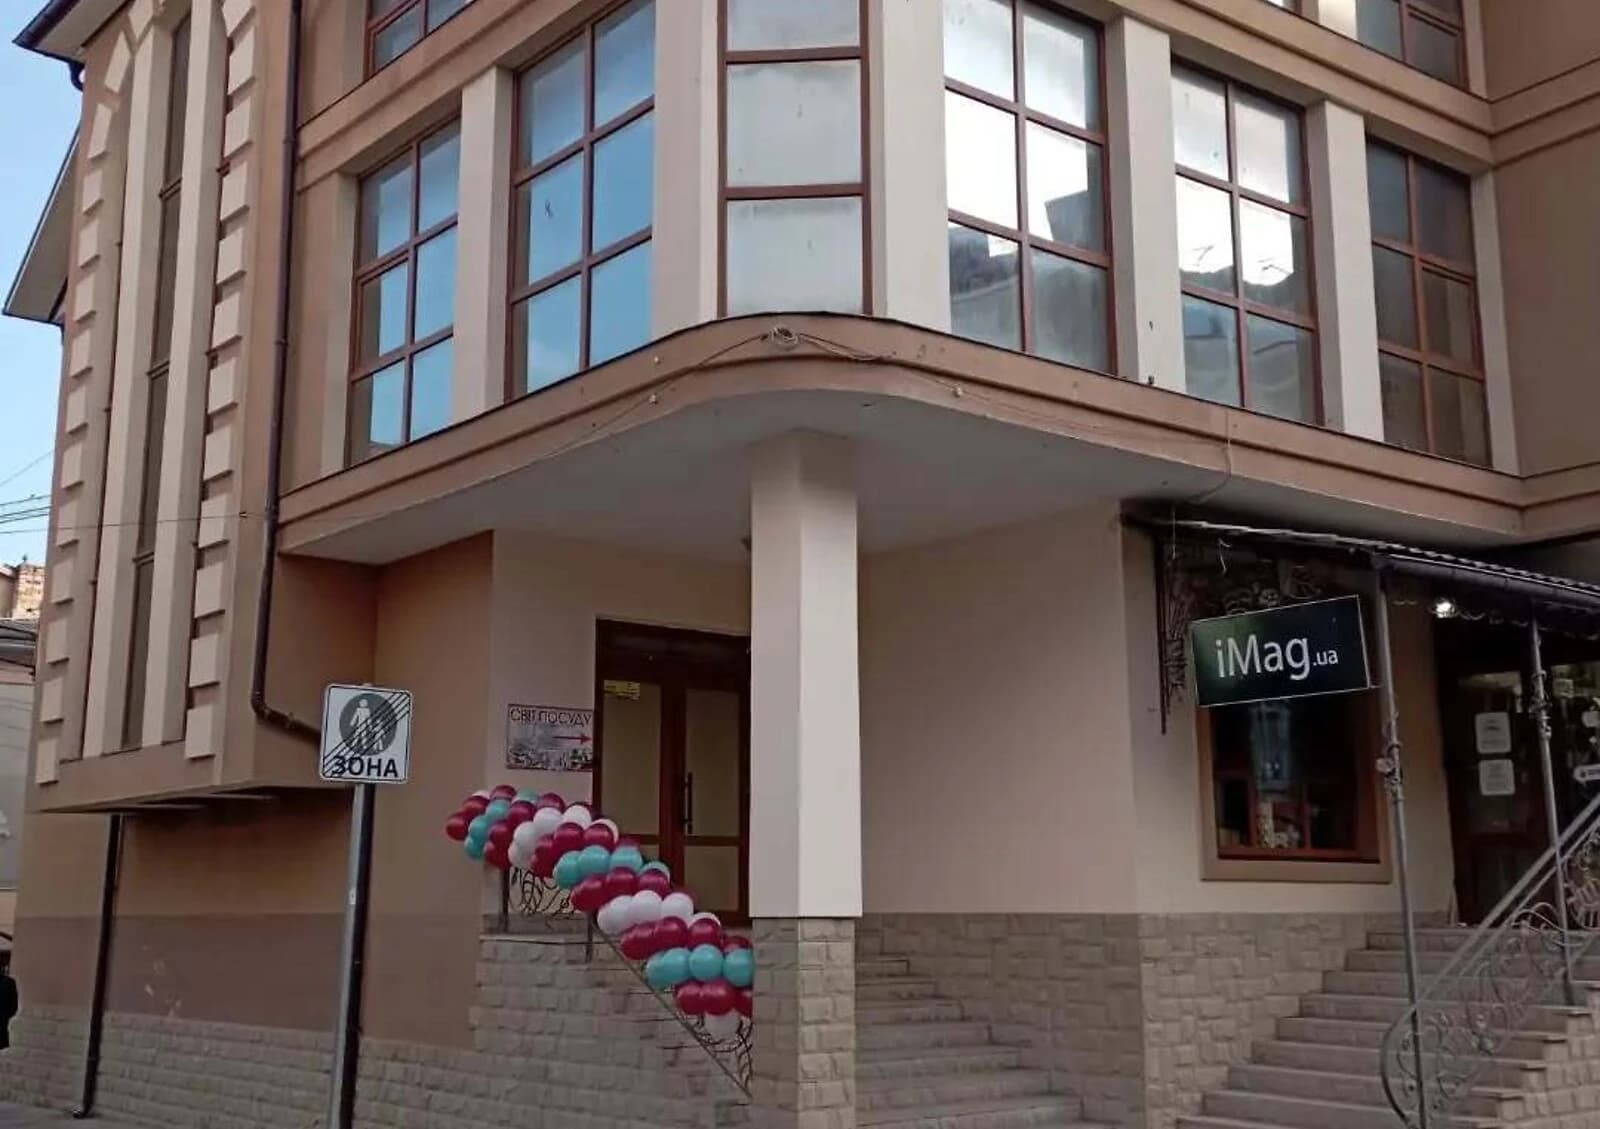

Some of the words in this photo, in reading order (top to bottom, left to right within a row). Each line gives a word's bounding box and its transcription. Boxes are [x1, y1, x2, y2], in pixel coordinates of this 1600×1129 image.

[1215, 634, 1339, 681] iMag.ua
[510, 708, 536, 722] СВІТ
[539, 709, 592, 727] ПОСУДУ
[331, 755, 399, 778] ЗОНА
